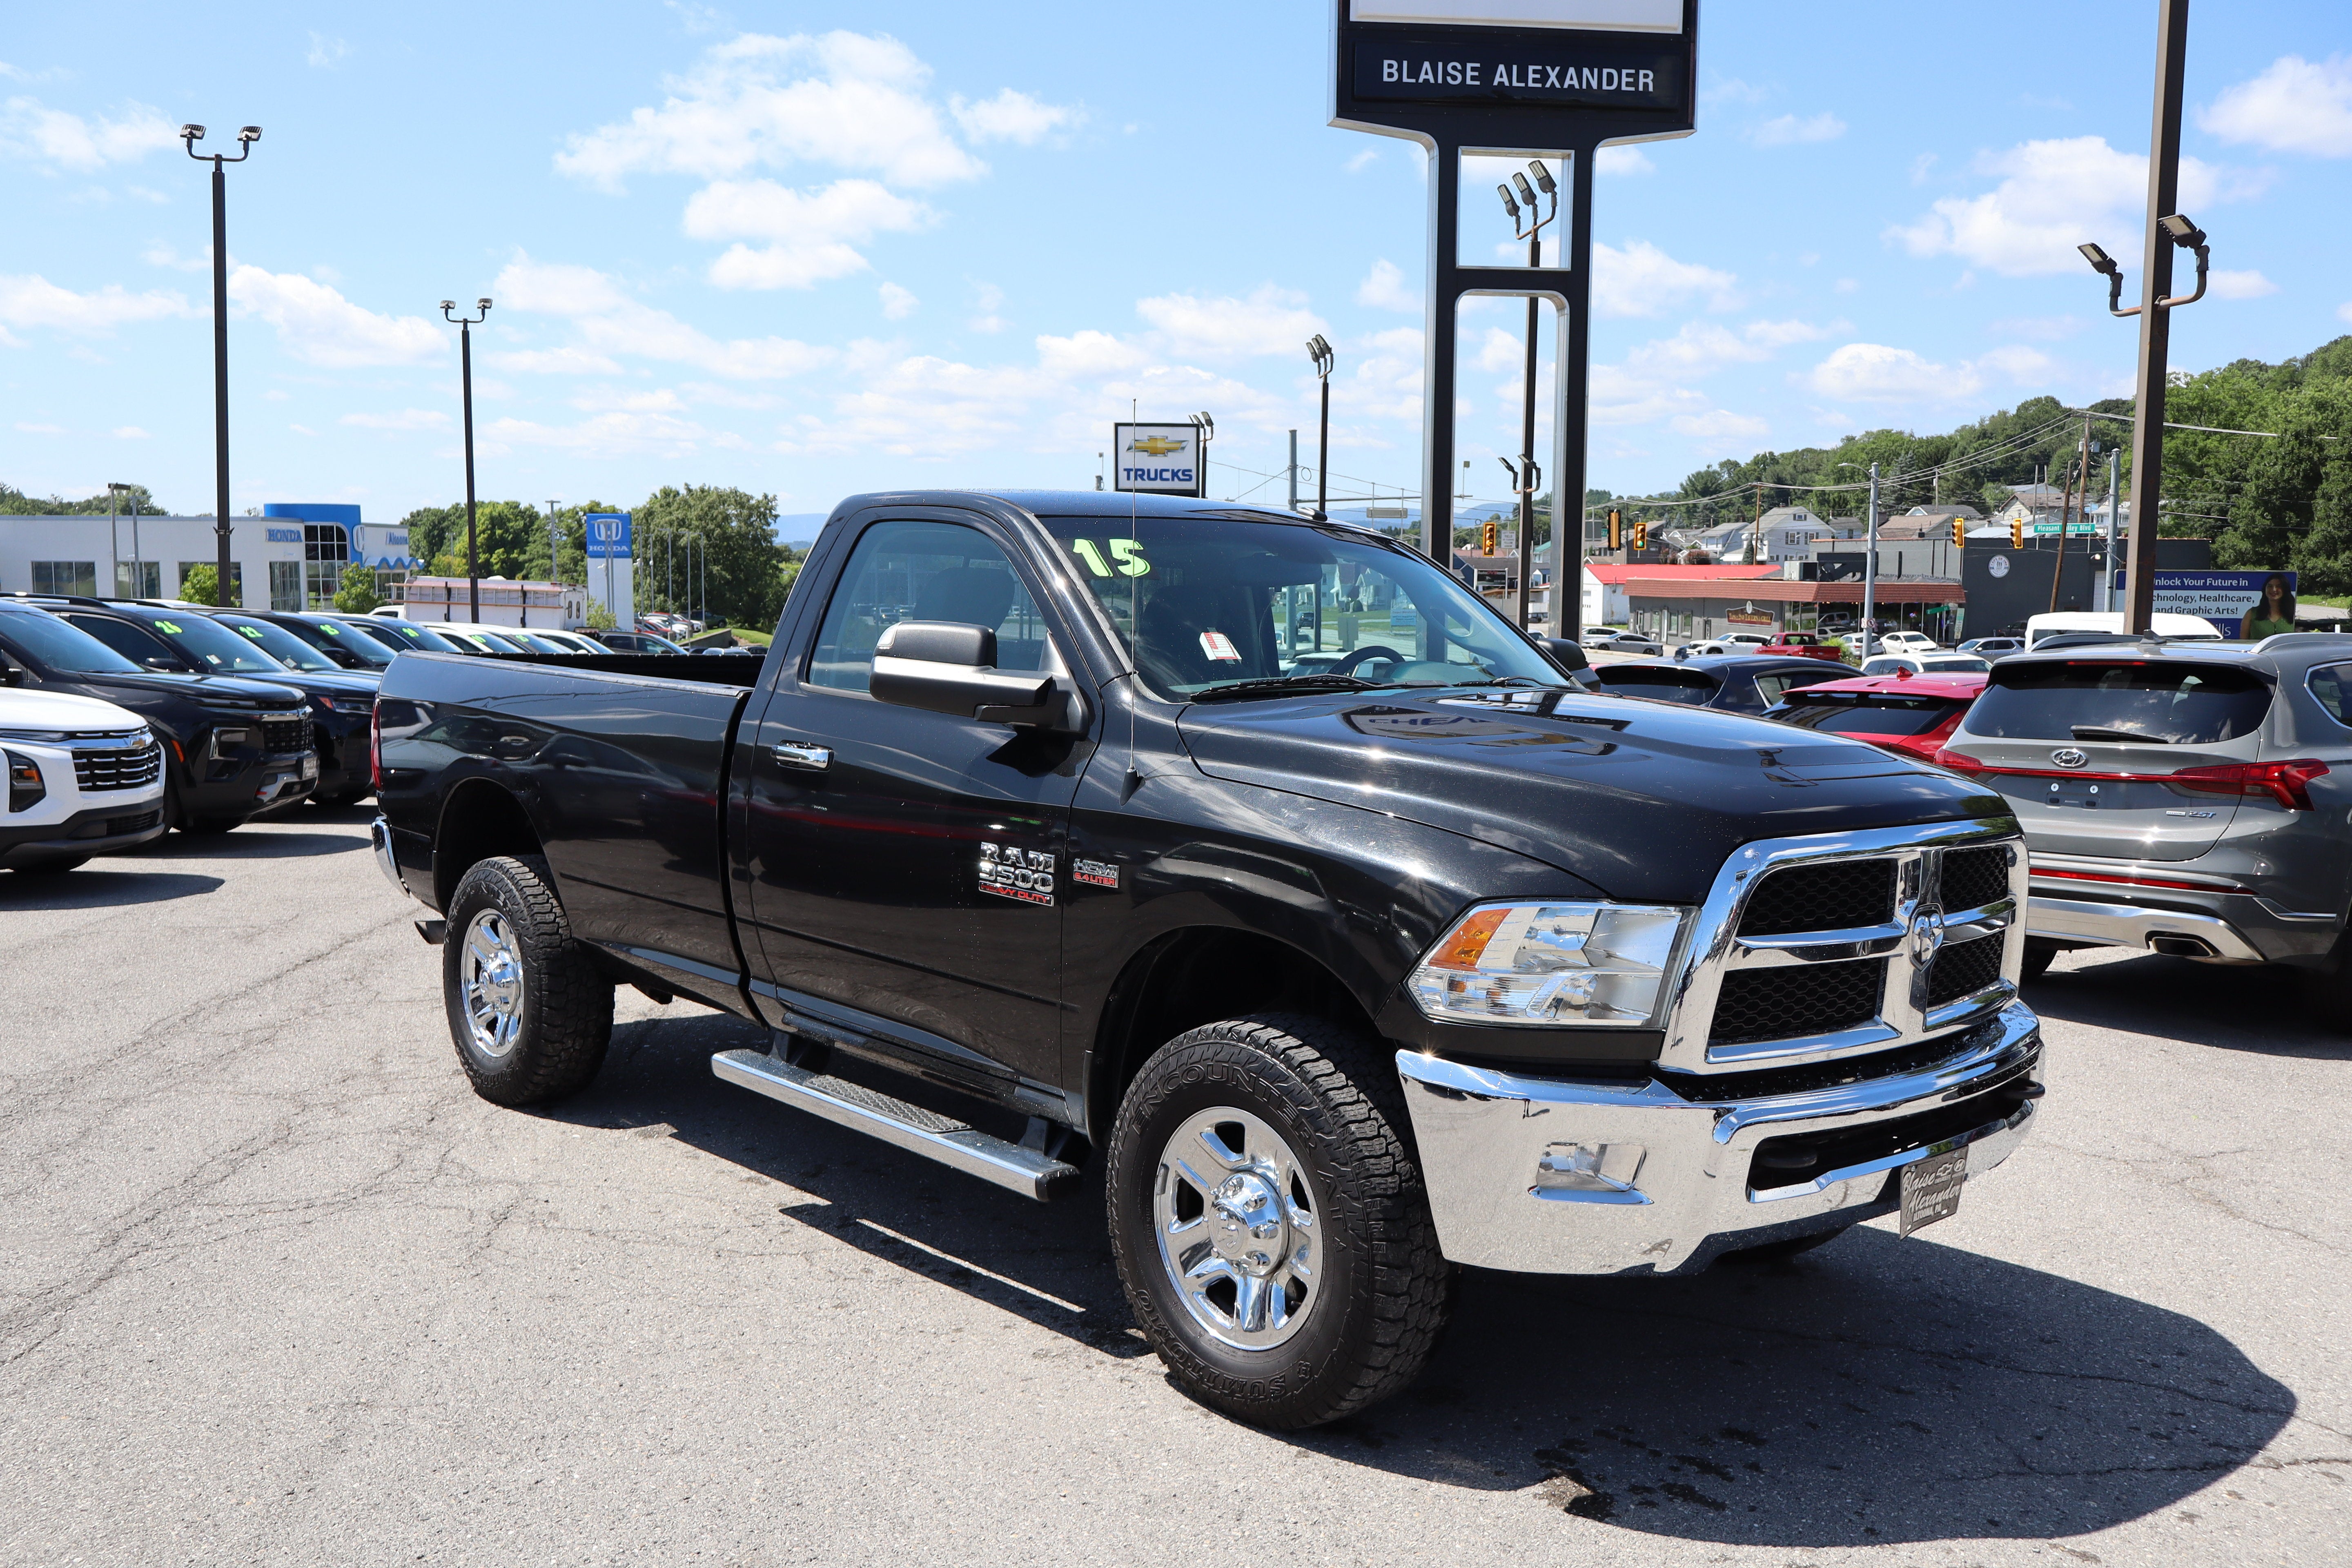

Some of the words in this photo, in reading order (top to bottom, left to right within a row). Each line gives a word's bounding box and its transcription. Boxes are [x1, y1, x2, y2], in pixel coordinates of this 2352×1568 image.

[1383, 60, 1480, 85] BLAISE
[1493, 64, 1654, 92] ALEXANDER
[1124, 468, 1193, 481] TRUCKS
[267, 529, 303, 542] HONDA
[1073, 539, 1151, 577] 15
[2183, 578, 2205, 586] Your
[2207, 578, 2238, 586] Future
[2239, 578, 2248, 586] in
[2199, 594, 2255, 604] Healthcare,
[2175, 607, 2212, 615] Graphic
[980, 841, 1056, 874] RAM
[979, 861, 1055, 893] 3500
[1074, 858, 1119, 878] HEMI
[1075, 872, 1089, 881] 6.4
[1090, 875, 1115, 886] LITER
[981, 884, 1016, 896] HEAVY
[1018, 891, 1047, 903] DUTY
[1903, 1171, 1936, 1196] Blaise
[1906, 1180, 1961, 1218] Alexander
[1935, 1202, 1942, 1214] PA
